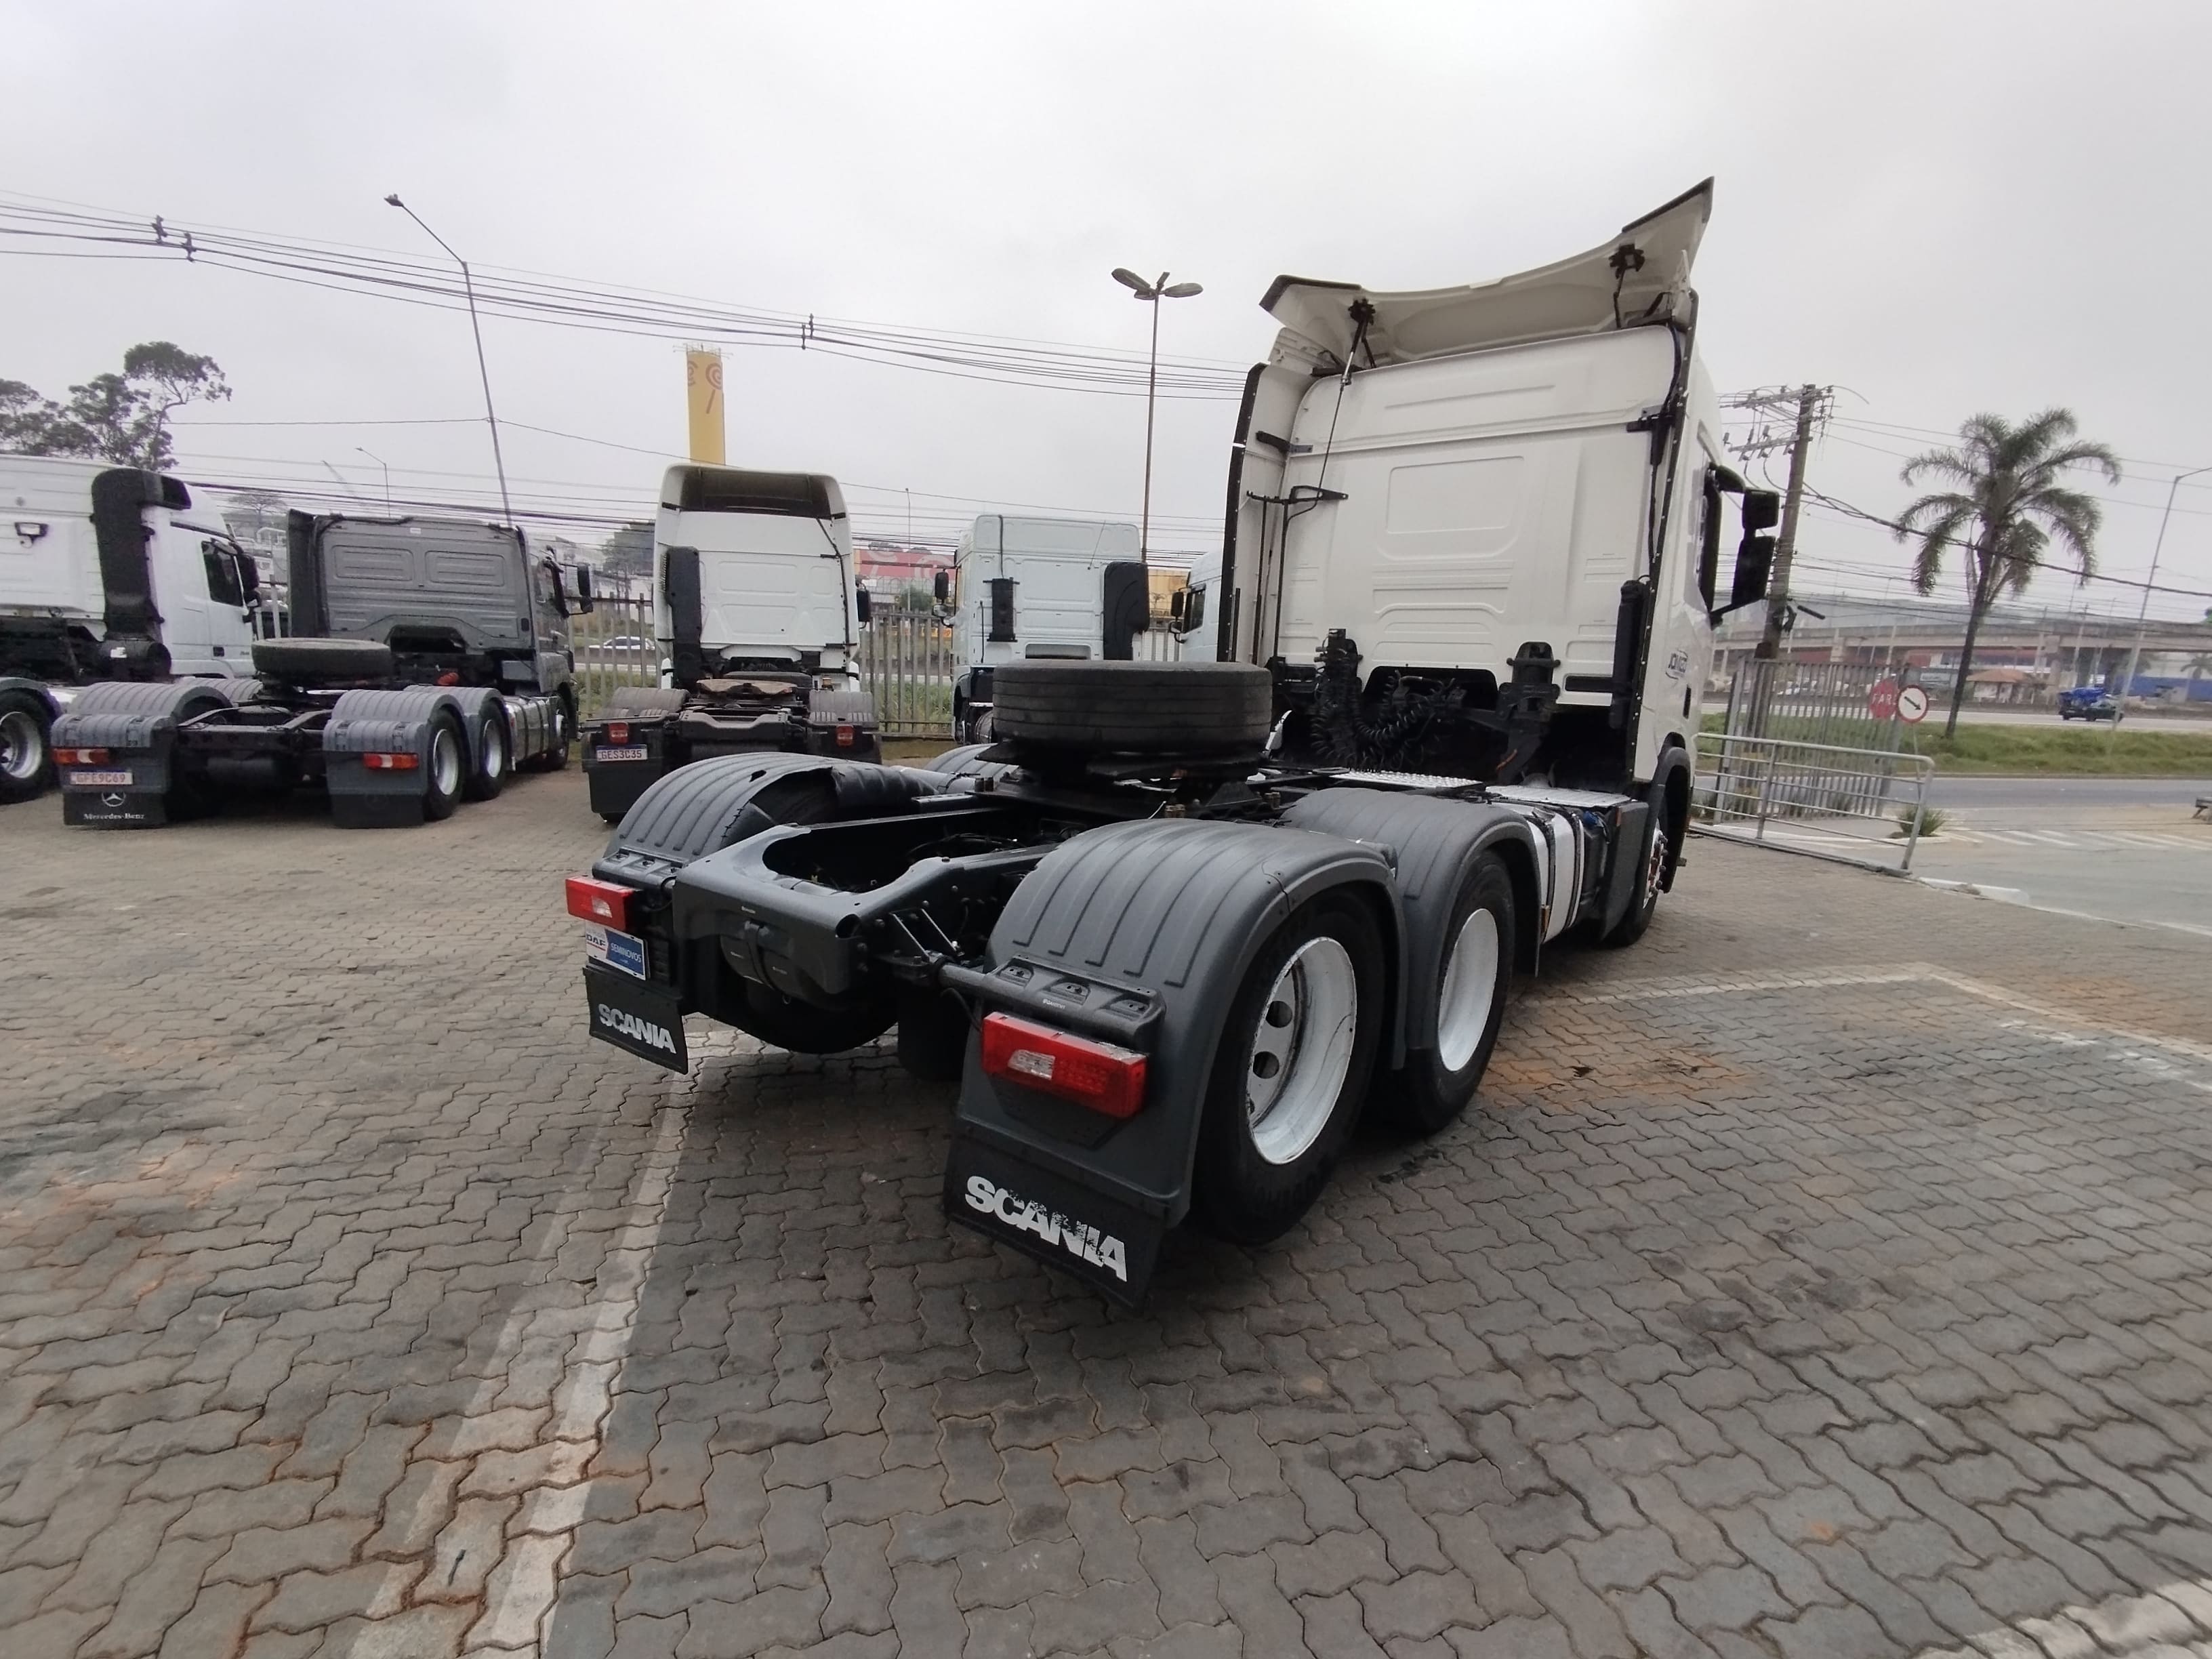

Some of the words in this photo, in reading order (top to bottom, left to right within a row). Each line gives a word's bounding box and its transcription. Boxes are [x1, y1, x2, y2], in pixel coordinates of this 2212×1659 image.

[601, 750, 642, 760] GES3C35
[586, 934, 606, 946] DAF
[598, 1003, 677, 1054] SCANIA
[964, 1175, 1127, 1282] SCANIA
